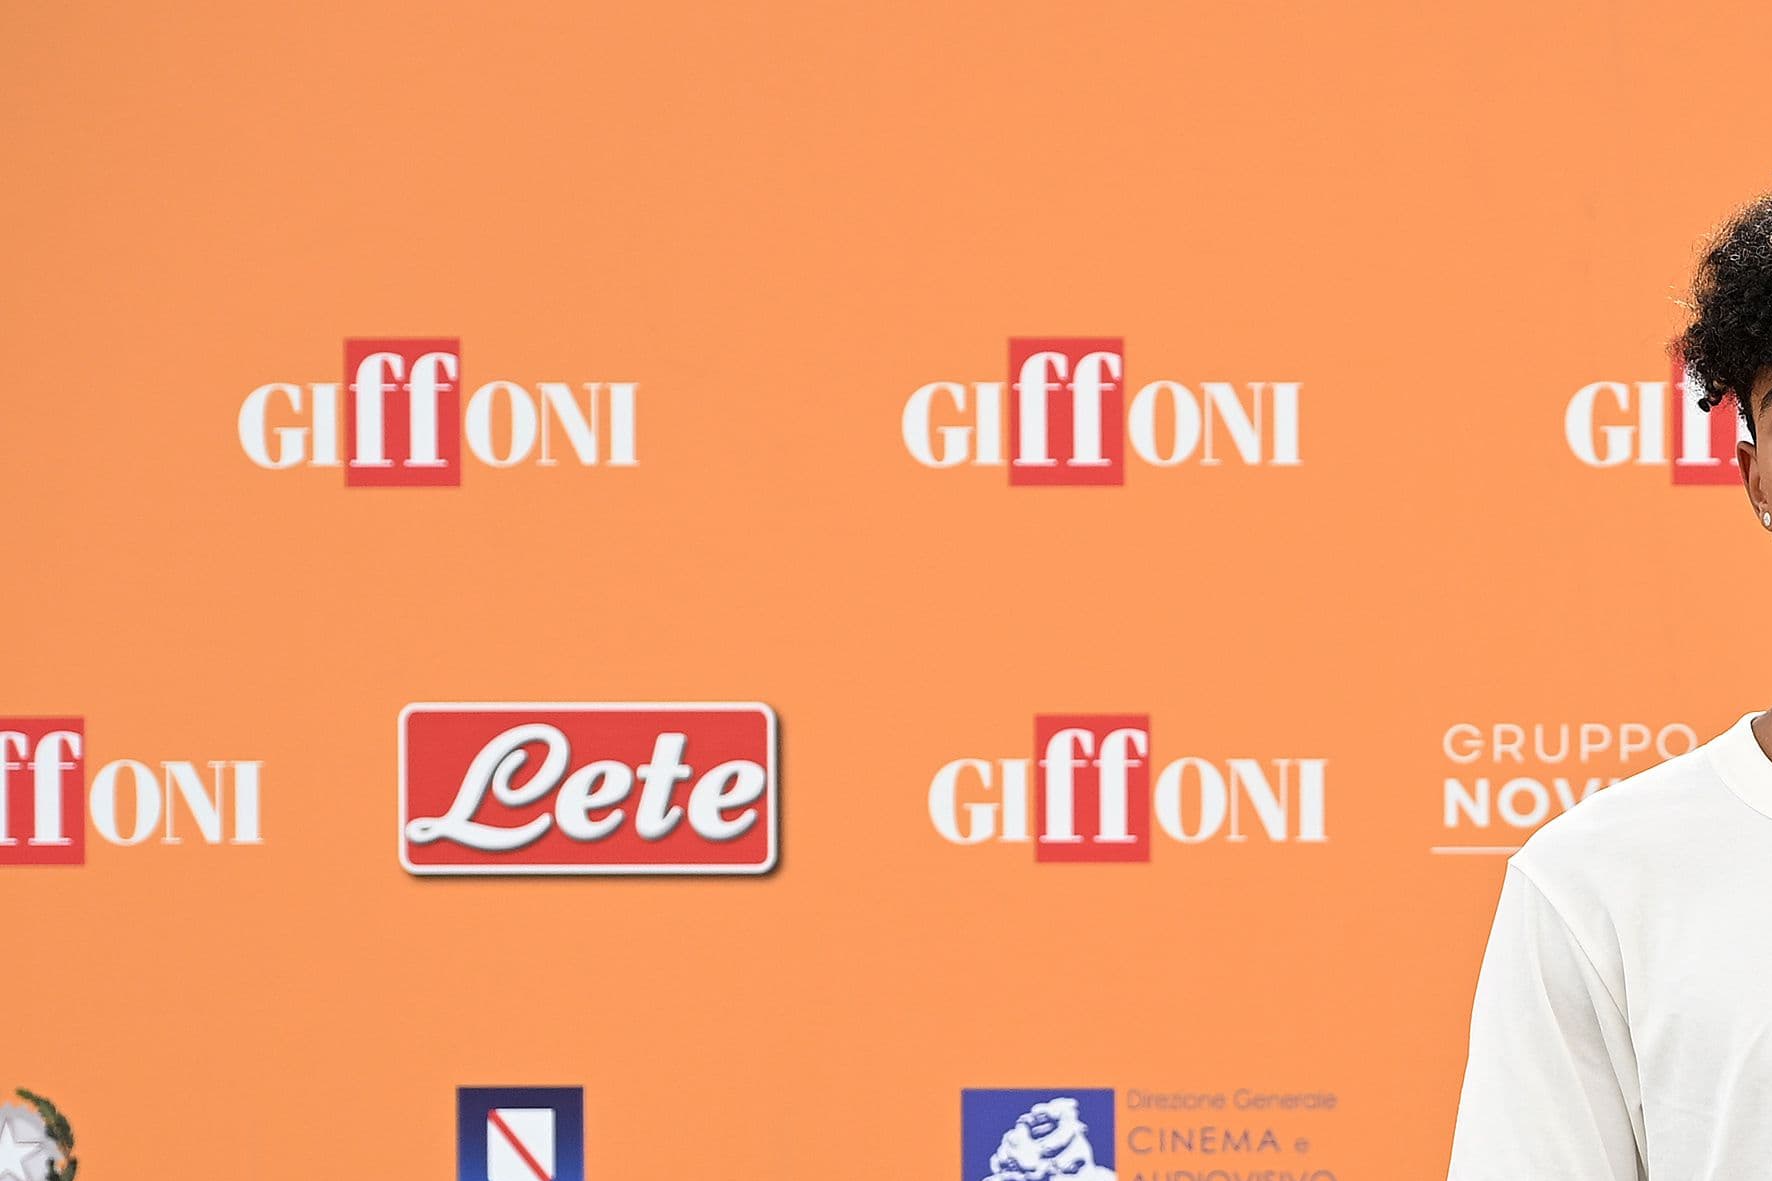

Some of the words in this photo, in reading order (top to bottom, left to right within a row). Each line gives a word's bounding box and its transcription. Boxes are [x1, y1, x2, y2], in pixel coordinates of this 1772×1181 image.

[239, 353, 640, 470] GIffONI
[903, 353, 1303, 469] GIffONI
[1443, 723, 1699, 763] GRUPPO
[405, 723, 767, 852] Lete
[929, 730, 1329, 846] GIffONI
[1444, 777, 1622, 827] NOV
[1127, 1089, 1226, 1110] Direzione
[1233, 1089, 1338, 1110] Generale
[1127, 1126, 1281, 1154] CINEMA
